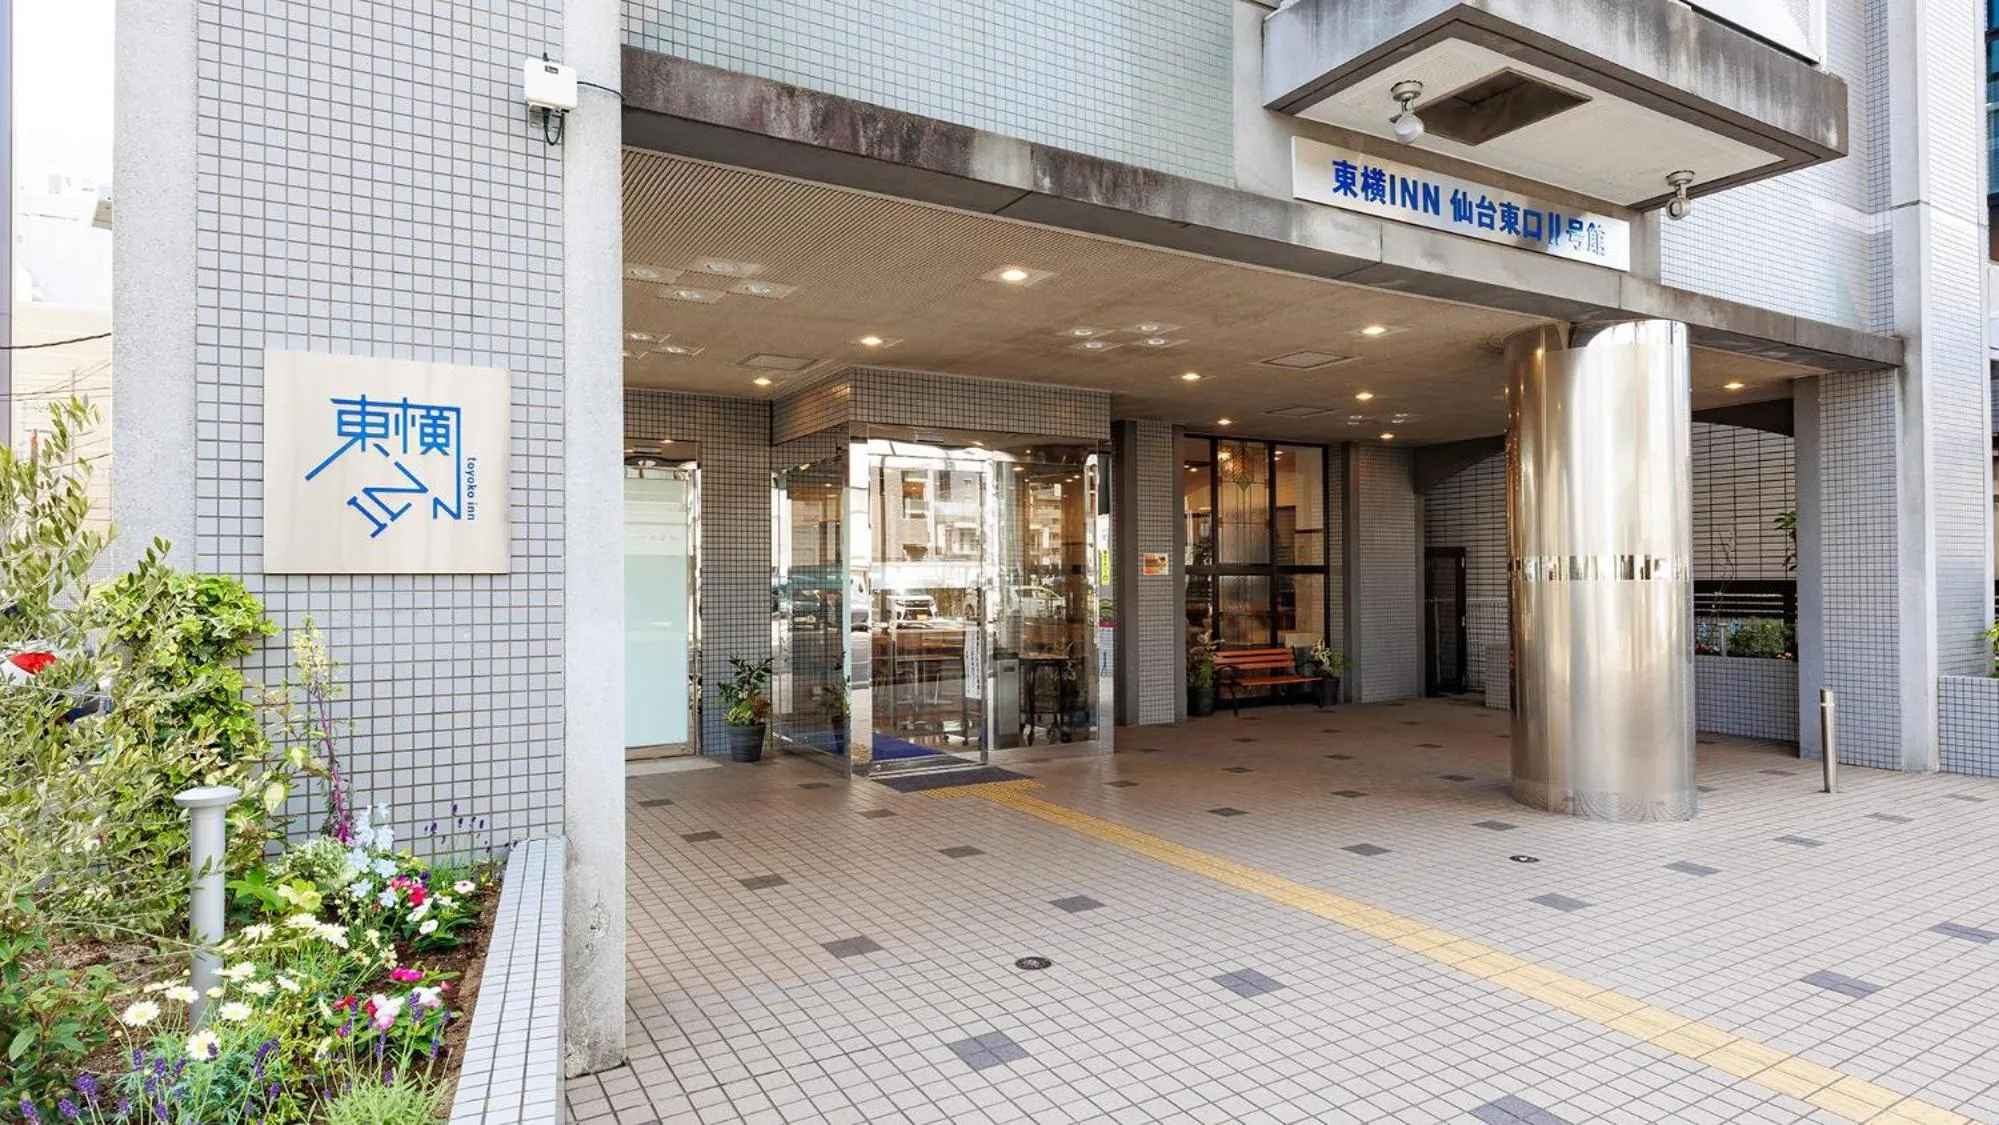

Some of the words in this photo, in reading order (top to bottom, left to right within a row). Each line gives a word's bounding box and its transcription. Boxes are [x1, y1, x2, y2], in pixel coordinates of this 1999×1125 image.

[1332, 160, 1440, 216] 東横INN
[465, 456, 477, 498] toyoko
[467, 502, 477, 520] inn
